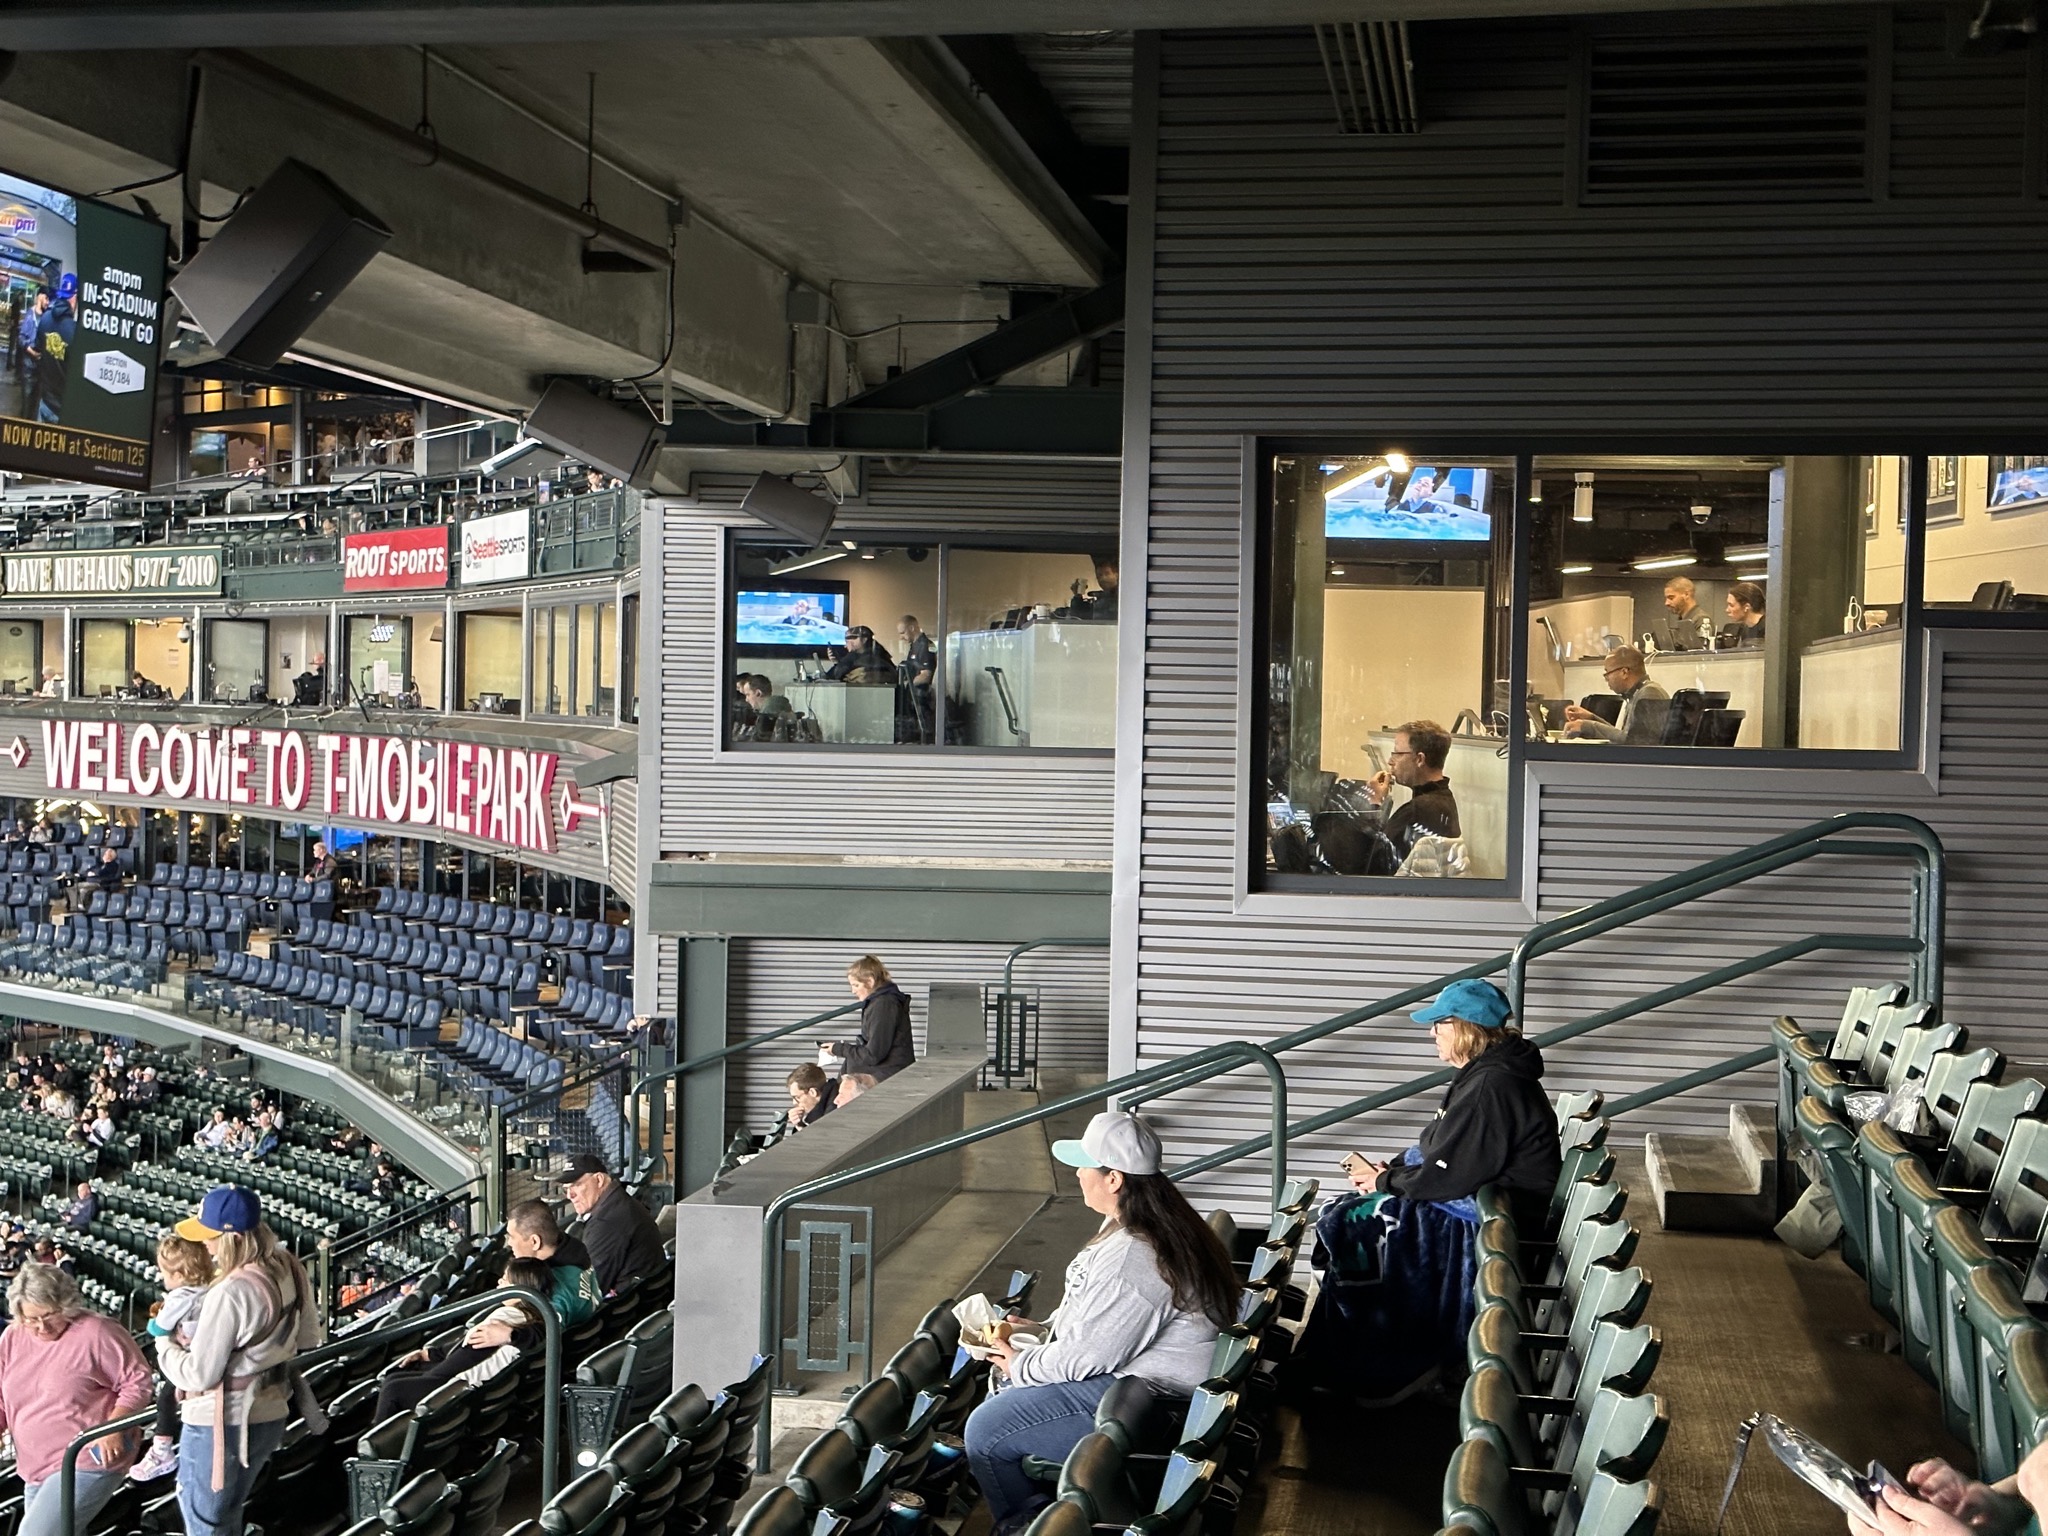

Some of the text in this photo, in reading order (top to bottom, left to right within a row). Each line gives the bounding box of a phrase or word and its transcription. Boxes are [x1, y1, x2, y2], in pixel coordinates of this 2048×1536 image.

[103, 266, 142, 290] ampm
[83, 282, 157, 320] IN-STADIUM
[83, 309, 119, 336] GRAB
[136, 322, 154, 344] GO
[99, 368, 131, 386] 183/184
[105, 355, 127, 369] SECTION
[2, 424, 145, 467] NOW OPEN at Section 125
[7, 554, 218, 592] DAVE NIEHAUS 1977-2010
[345, 544, 390, 578] ROOT
[41, 720, 554, 854] WELCOME TO T-MOBILE PARK
